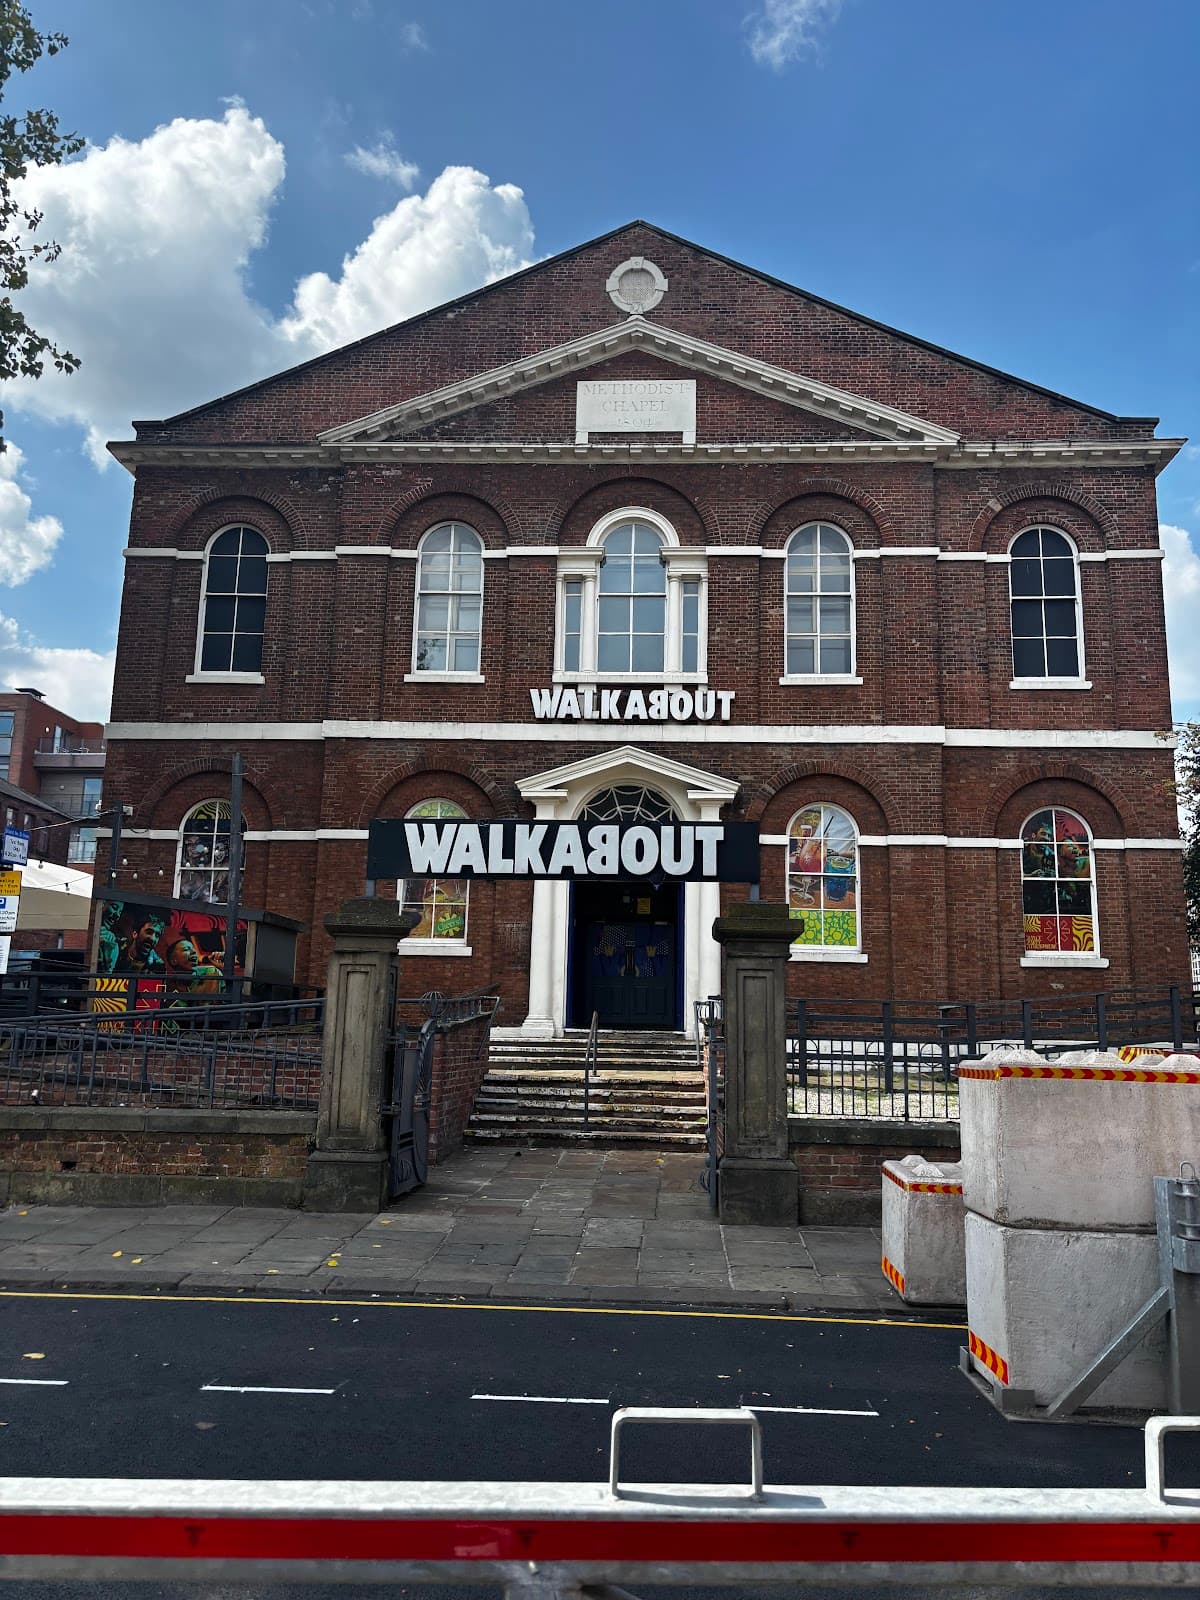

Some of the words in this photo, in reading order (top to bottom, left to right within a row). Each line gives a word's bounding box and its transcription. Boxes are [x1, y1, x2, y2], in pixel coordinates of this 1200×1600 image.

[584, 383, 689, 395] METHODIST
[602, 400, 668, 412] CHAPEL
[530, 689, 735, 720] WALKABOUT
[404, 823, 724, 875] WALKABOUT
